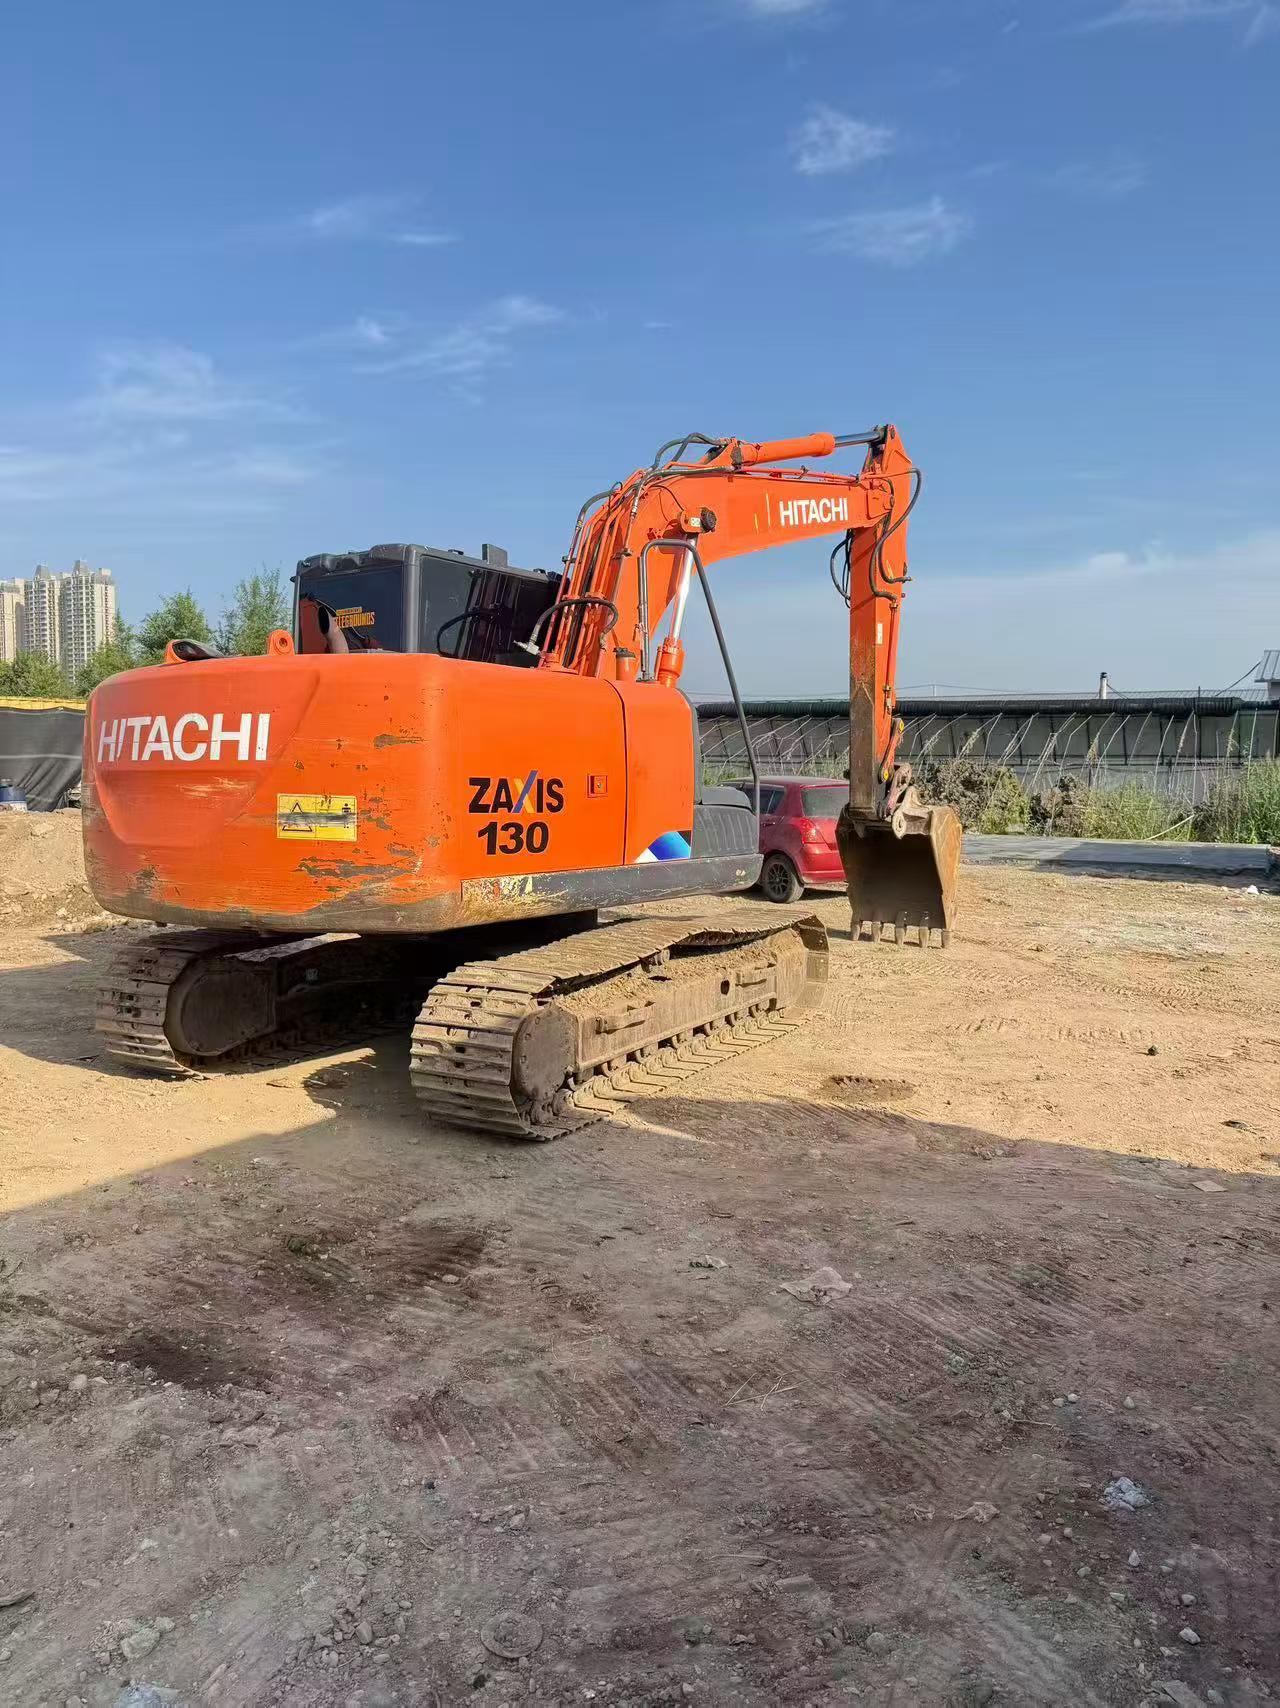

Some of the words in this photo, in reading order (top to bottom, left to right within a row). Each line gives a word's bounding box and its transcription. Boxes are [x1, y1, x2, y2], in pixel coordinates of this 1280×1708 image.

[779, 497, 848, 526] HITACHI
[97, 712, 271, 763] HITACHI
[469, 769, 564, 813] ZAXIS
[478, 821, 549, 855] 130
